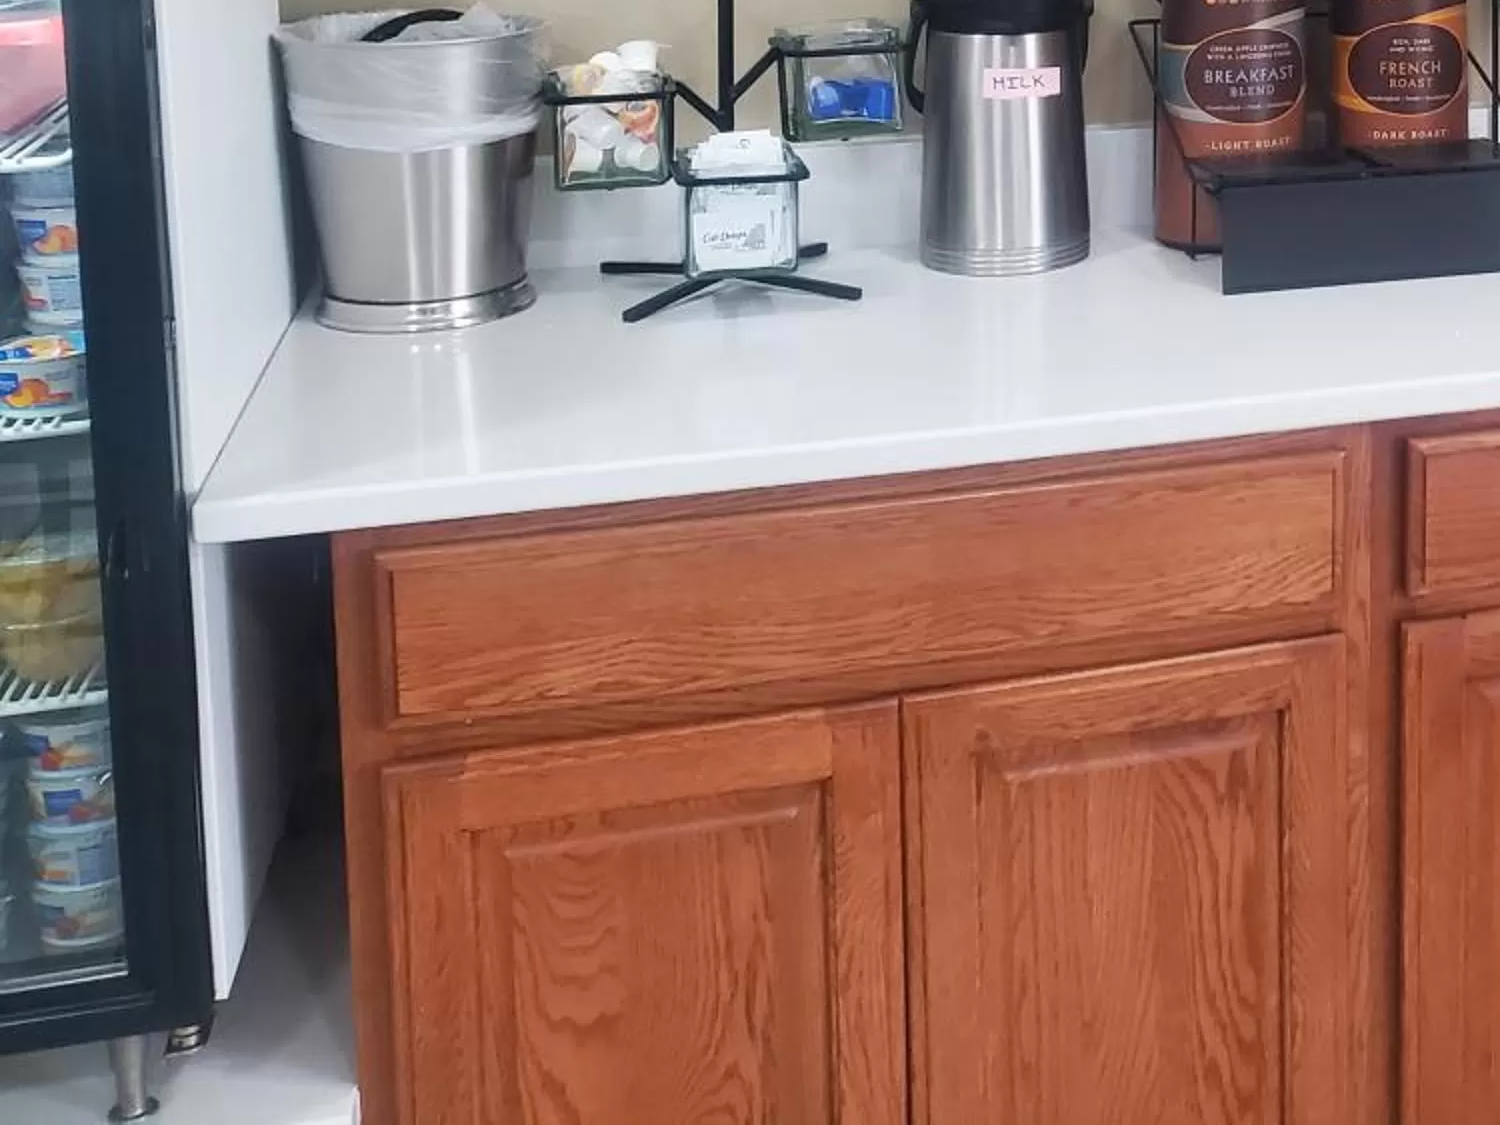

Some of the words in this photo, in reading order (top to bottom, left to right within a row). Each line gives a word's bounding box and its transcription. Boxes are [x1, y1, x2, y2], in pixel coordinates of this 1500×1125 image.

[1203, 64, 1295, 85] BREAKFAST
[1379, 59, 1442, 77] FRENCH
[992, 75, 1045, 91] MILK
[1228, 84, 1276, 99] BLEND
[1373, 130, 1408, 141] DARK
[1211, 139, 1250, 151] LIGHT
